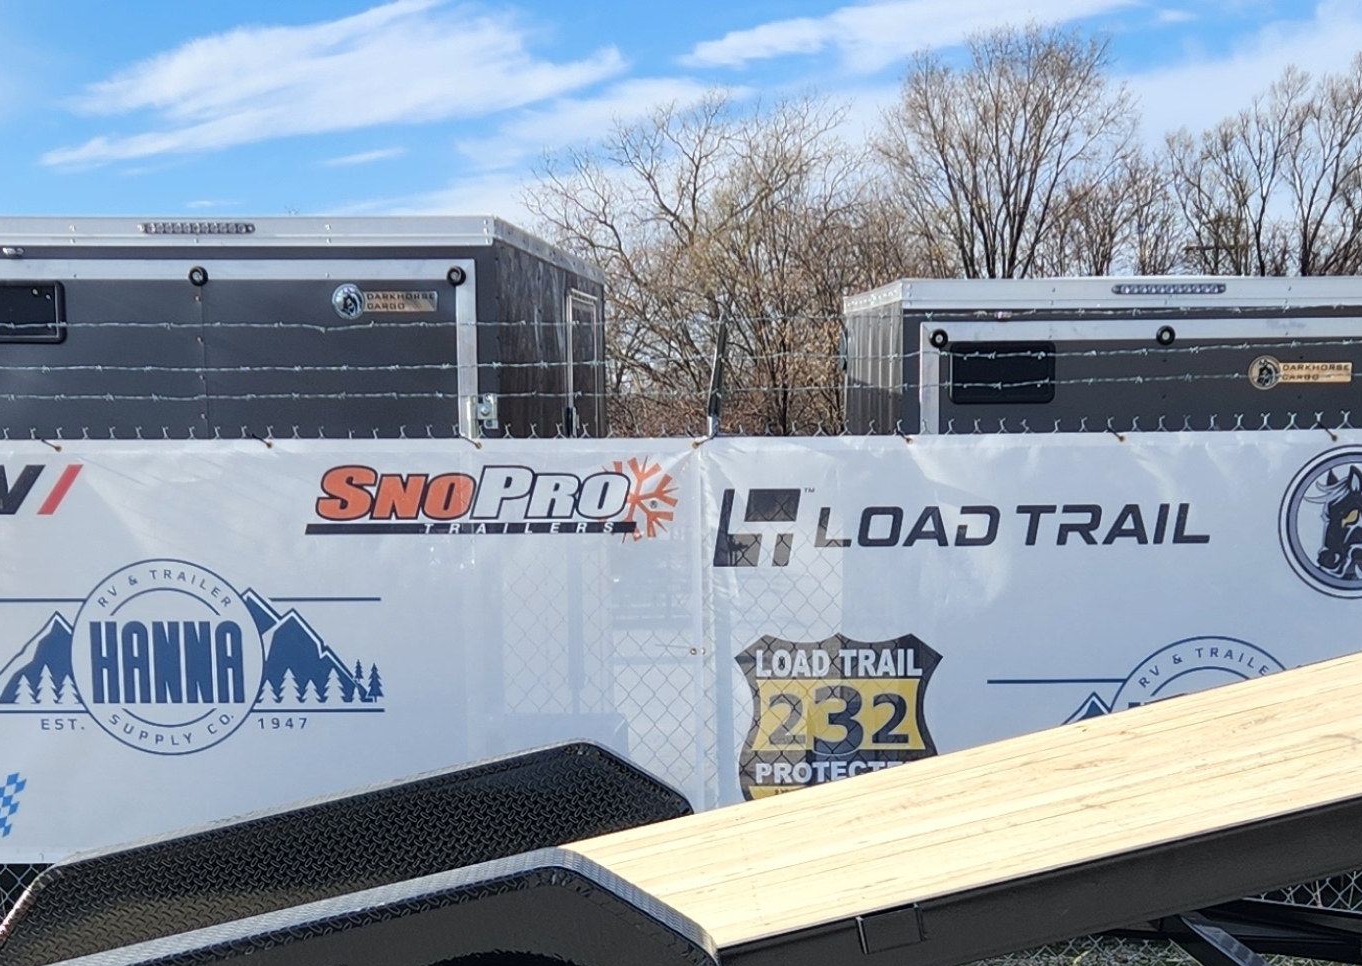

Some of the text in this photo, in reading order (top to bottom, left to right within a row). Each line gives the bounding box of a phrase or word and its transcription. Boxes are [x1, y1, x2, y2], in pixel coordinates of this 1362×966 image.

[422, 522, 614, 534] TRAILERS
[813, 502, 1211, 548] LOAD TRAIL
[97, 586, 119, 608] RV
[149, 568, 233, 608] TRAILER
[89, 619, 246, 704] HANNA
[755, 648, 923, 678] LOAD TRAIL
[1138, 664, 1160, 688] RV
[1194, 647, 1270, 677] TRAILE
[41, 718, 85, 731] EST.
[108, 713, 194, 746] SUPPLY
[258, 717, 308, 730] 1947
[768, 684, 910, 756] 232
